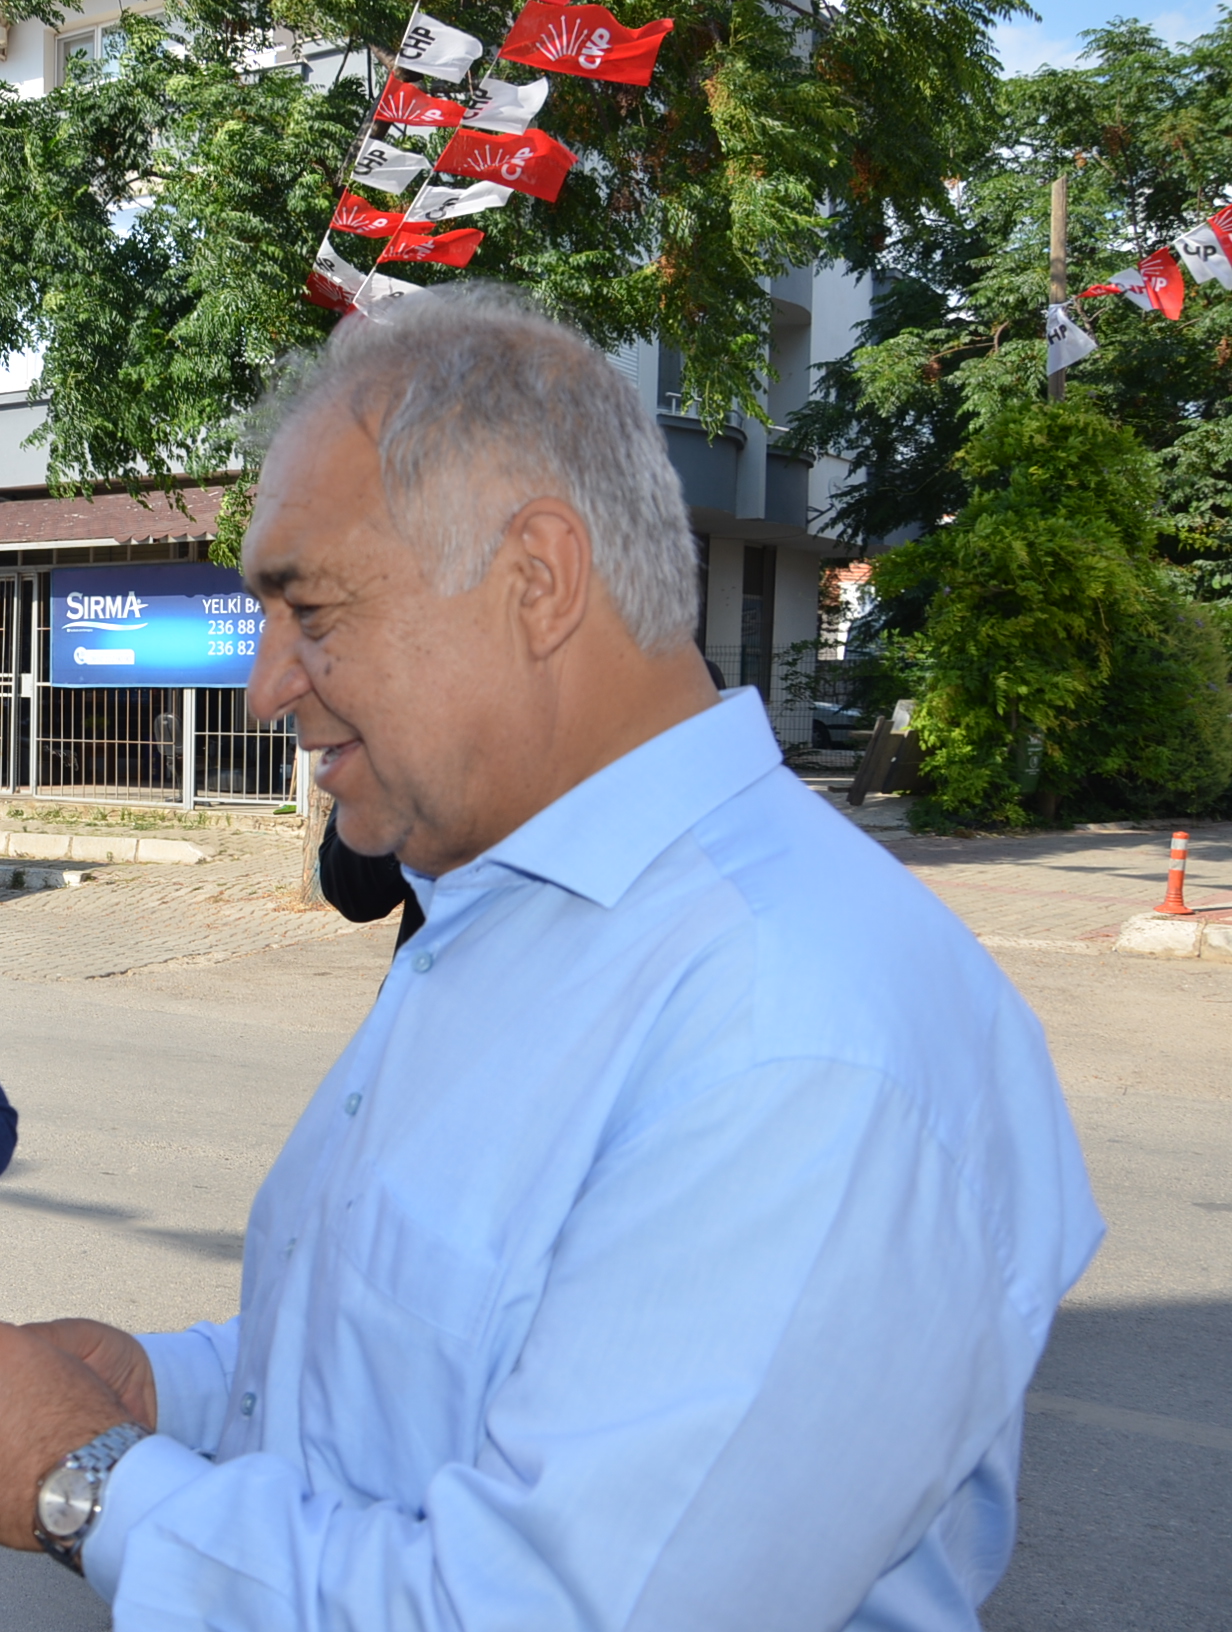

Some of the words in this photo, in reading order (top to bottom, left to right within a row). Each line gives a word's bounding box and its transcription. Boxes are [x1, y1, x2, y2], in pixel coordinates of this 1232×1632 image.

[399, 26, 436, 60] CHP
[354, 149, 388, 176] CHP
[66, 591, 148, 620] SIRMA
[202, 595, 241, 614] YELKİ
[208, 619, 234, 635] 236
[237, 619, 256, 635] 88
[208, 640, 234, 656] 236
[237, 640, 255, 656] 82
